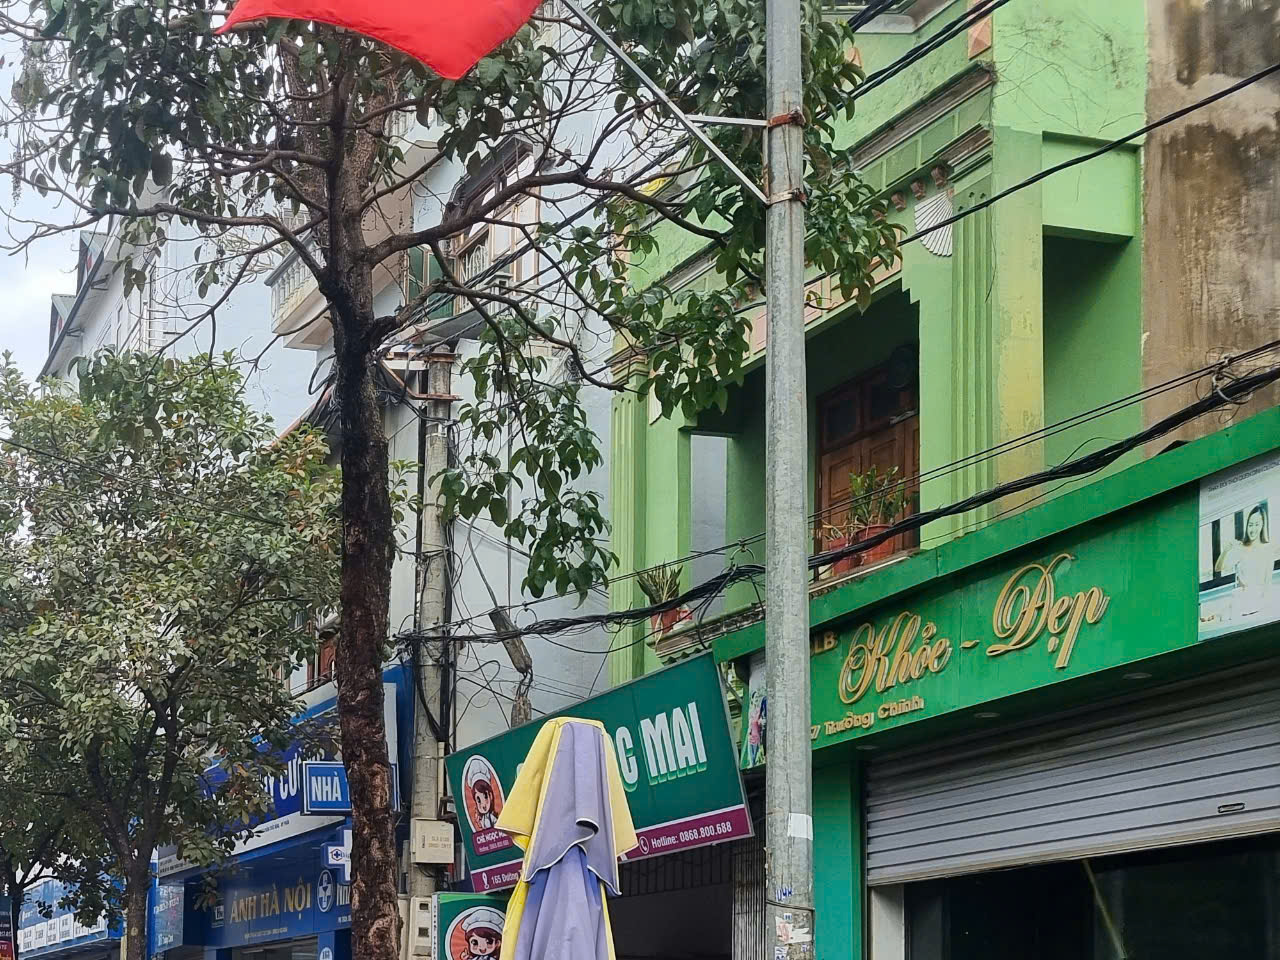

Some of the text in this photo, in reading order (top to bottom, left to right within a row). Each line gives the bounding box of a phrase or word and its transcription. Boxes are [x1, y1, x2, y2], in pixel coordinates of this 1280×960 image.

[814, 631, 838, 653] LB
[839, 610, 952, 704] Khỏe
[986, 553, 1110, 669] Đẹp
[640, 701, 708, 786] MAI
[311, 771, 342, 801] NHÀ
[651, 821, 732, 848] Hotline: 0868.800.688
[230, 875, 312, 924] ẢNH HÀ NỘI
